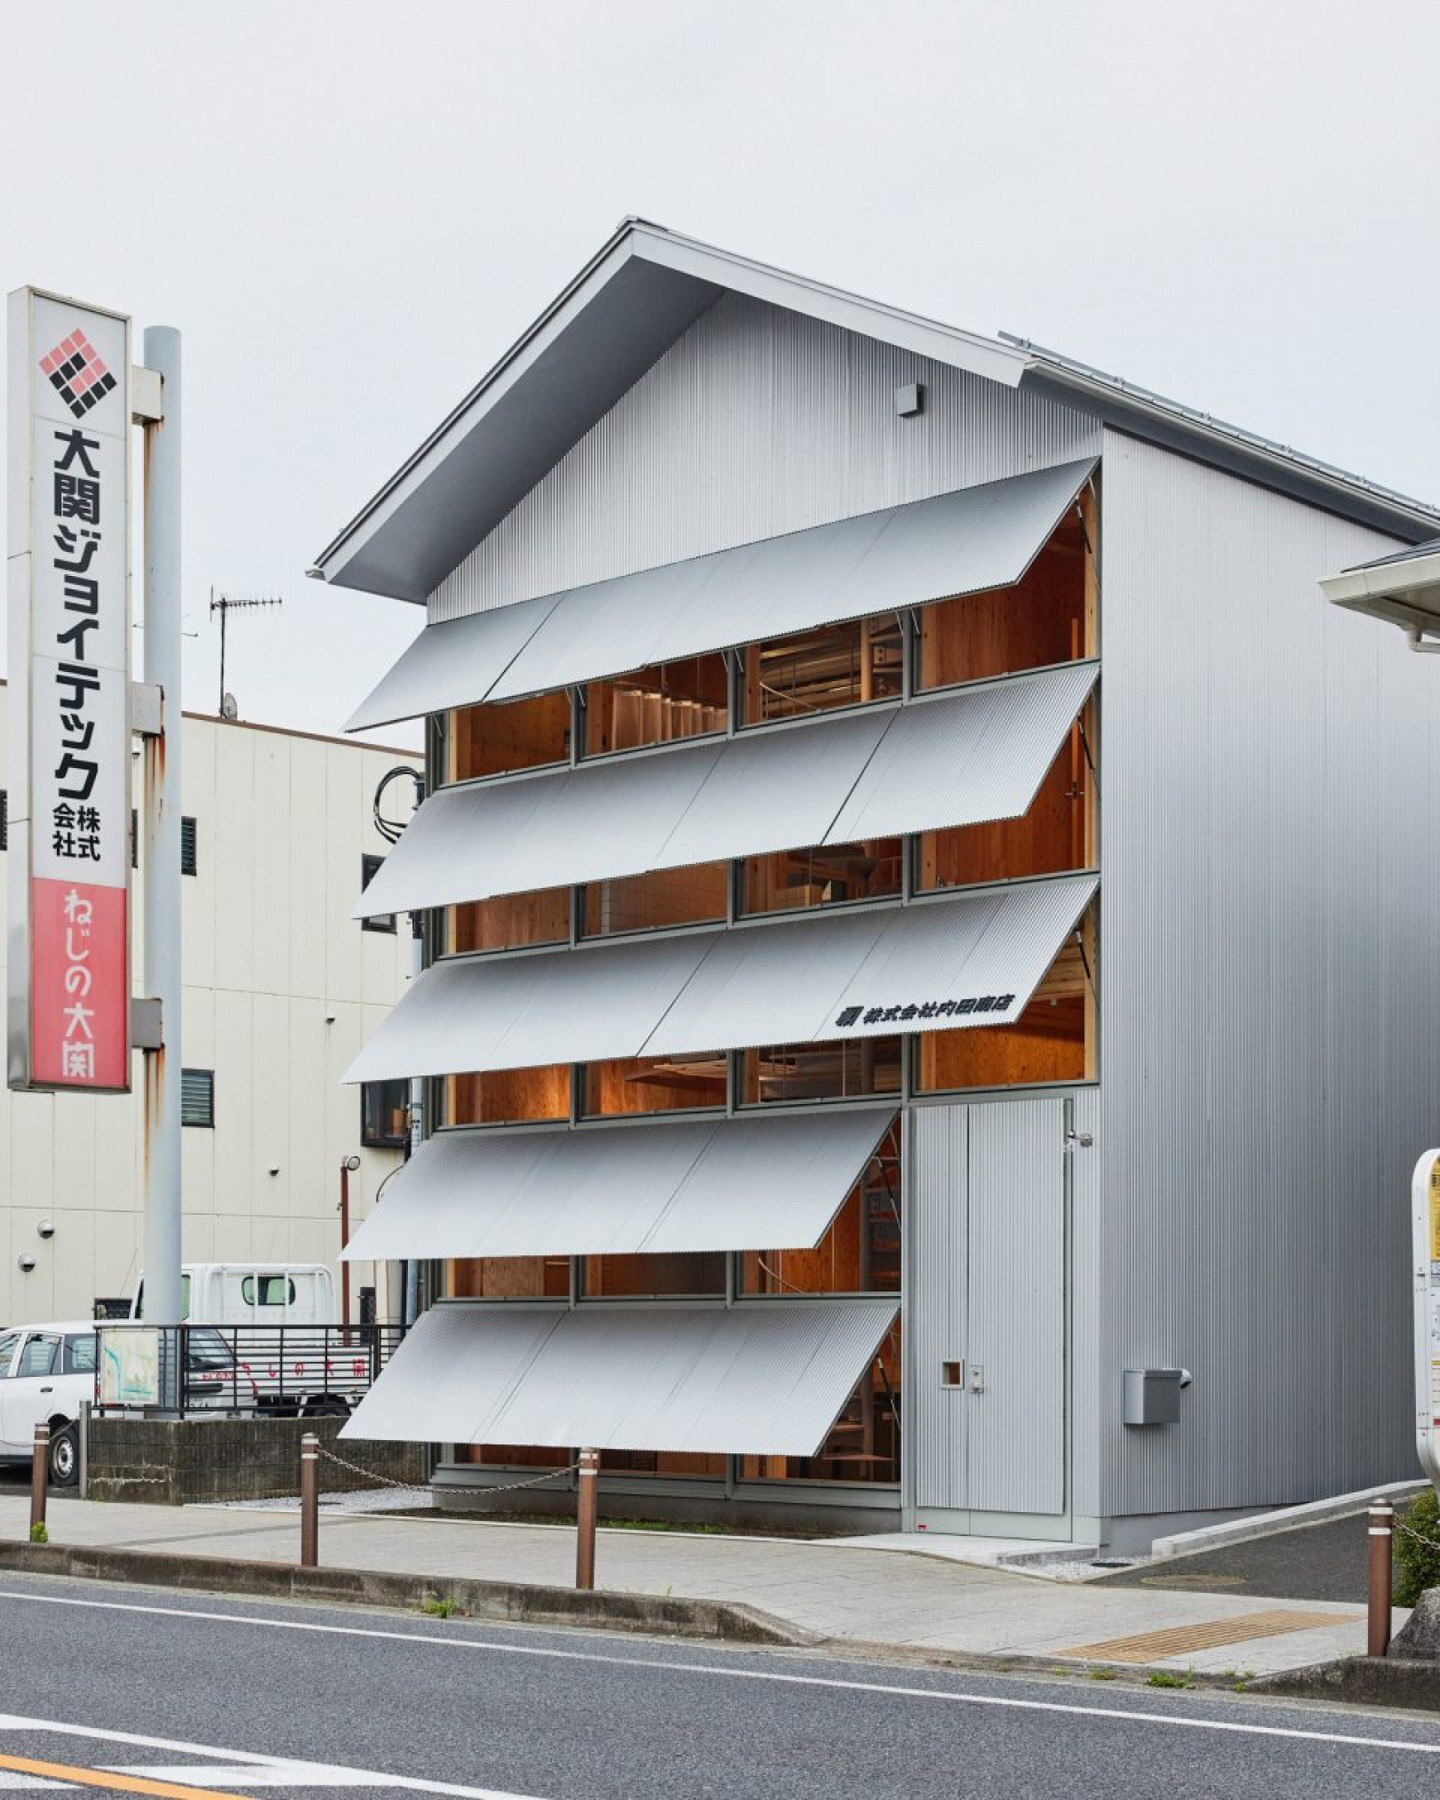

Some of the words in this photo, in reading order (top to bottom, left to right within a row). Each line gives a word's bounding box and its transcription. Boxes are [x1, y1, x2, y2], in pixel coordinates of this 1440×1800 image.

[54, 429, 101, 801] 大関ジョイテック
[62, 889, 95, 1079] ねじの大関
